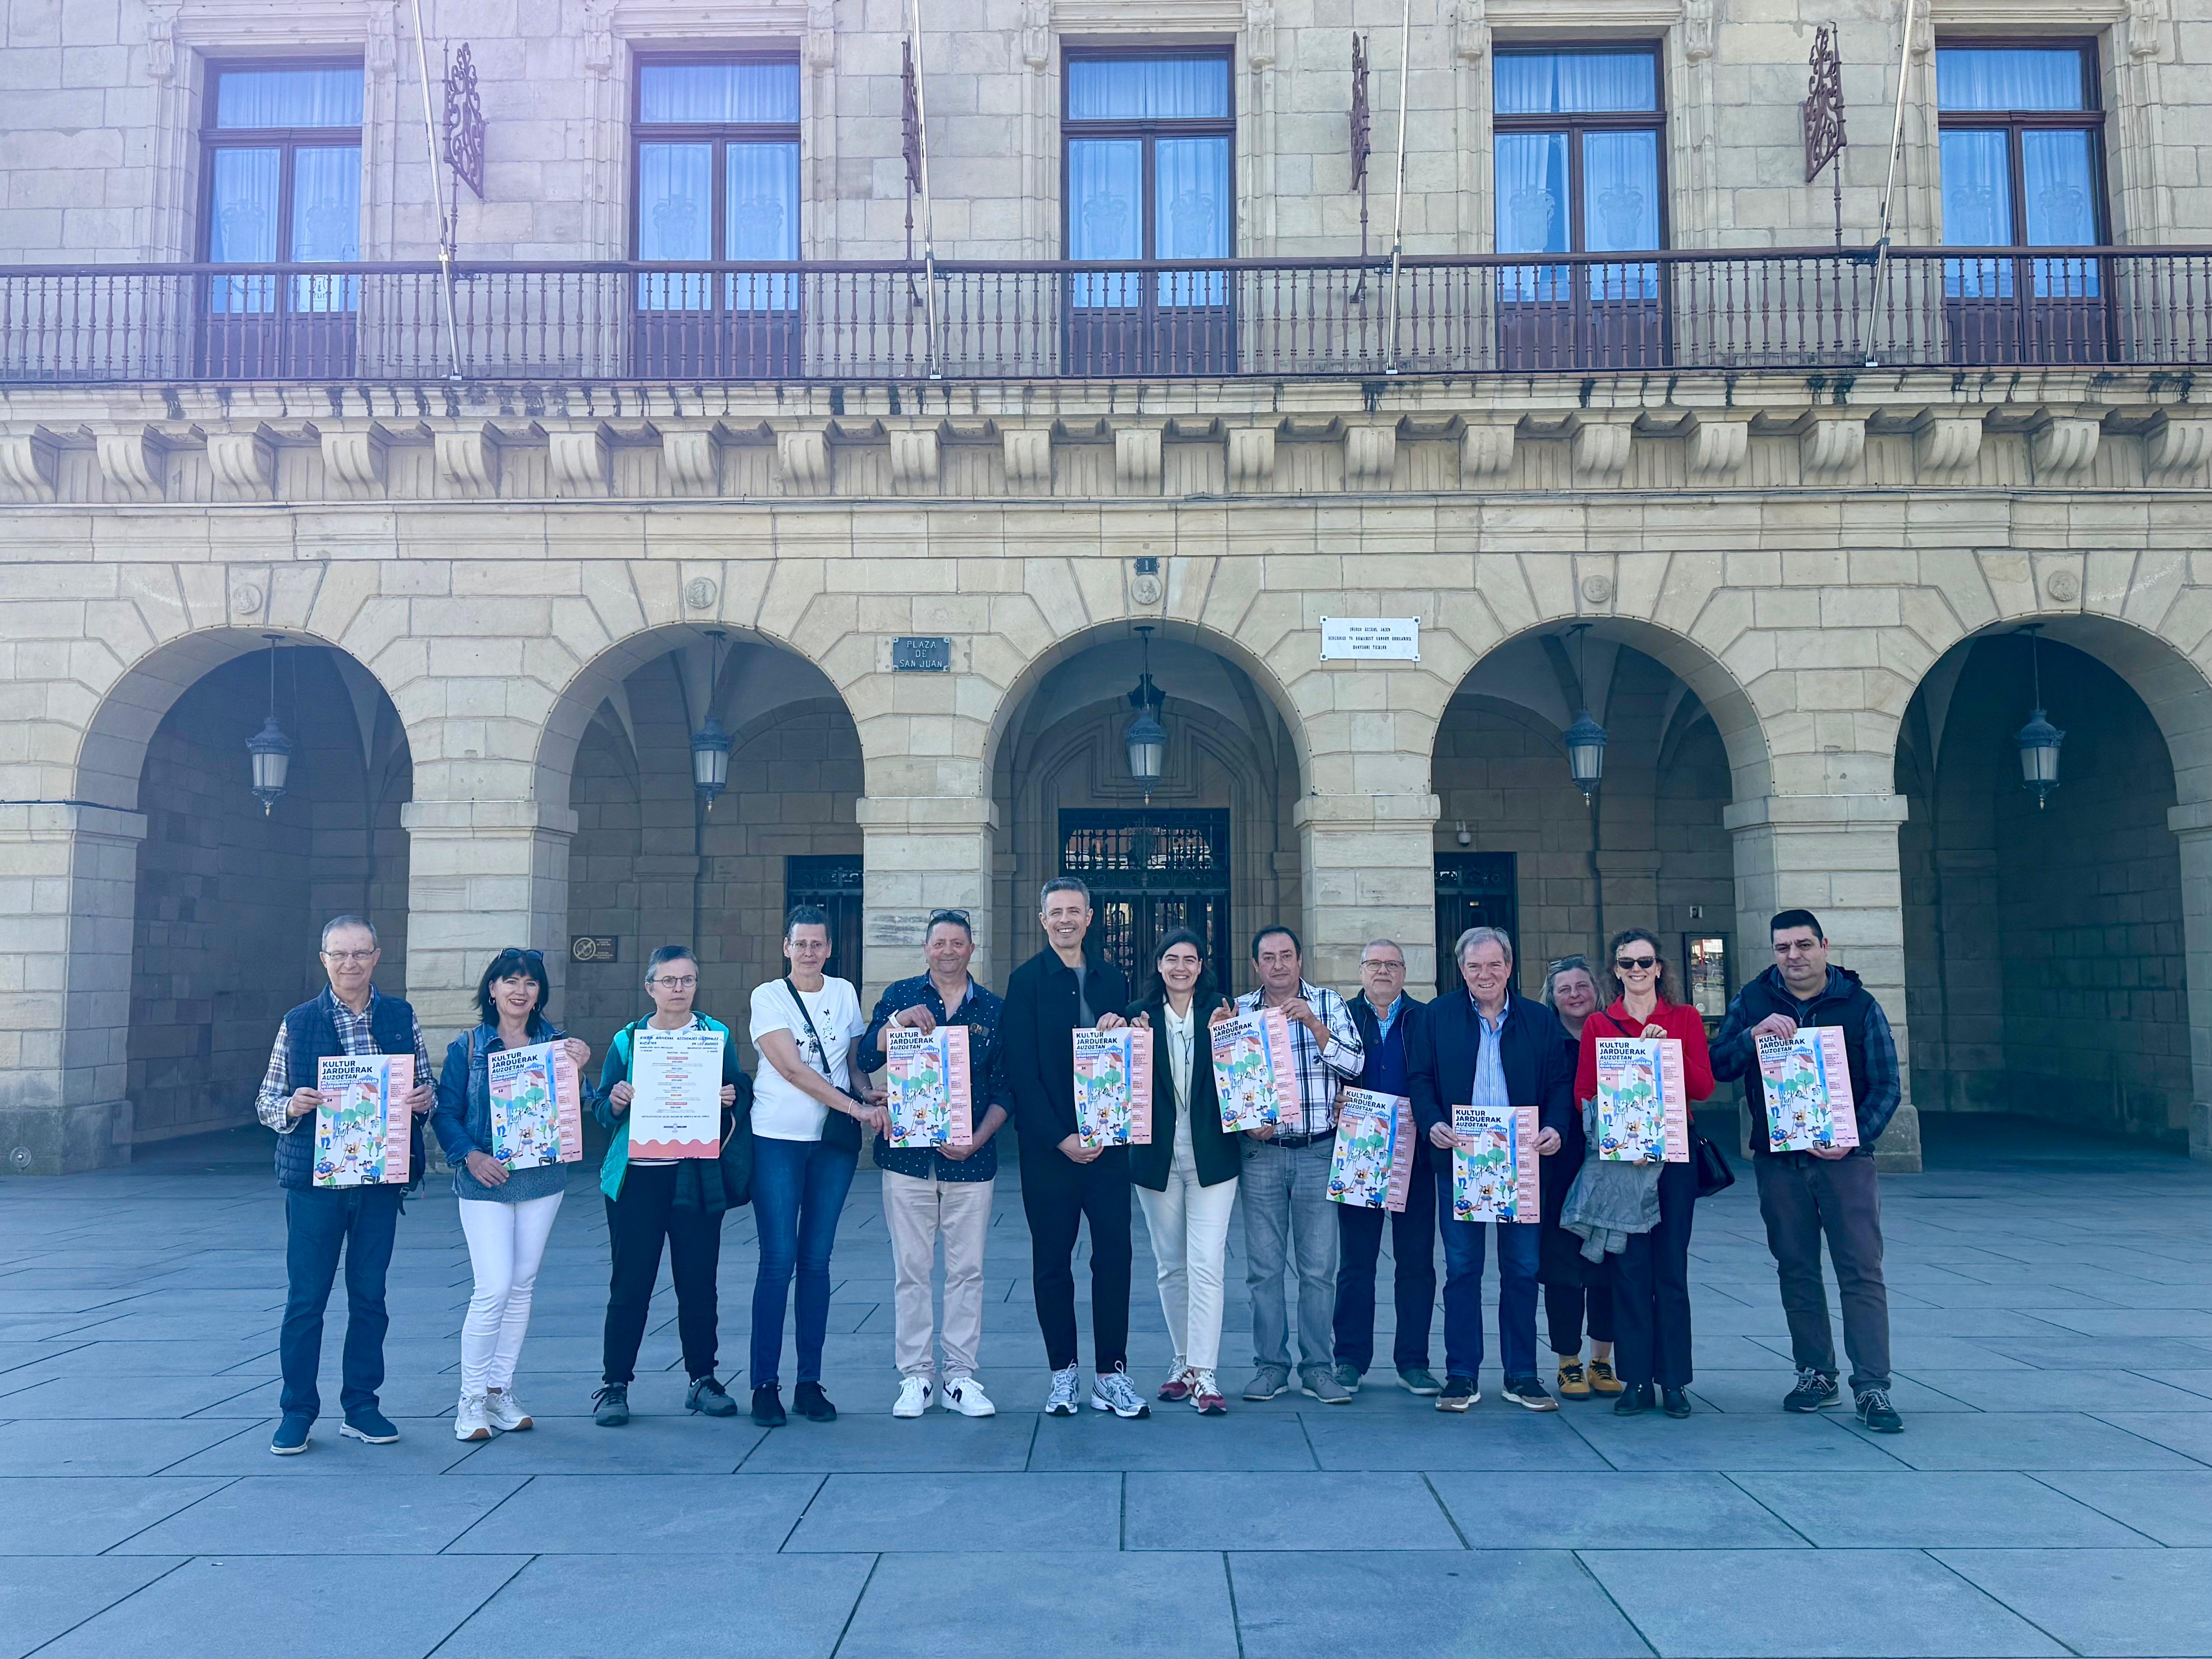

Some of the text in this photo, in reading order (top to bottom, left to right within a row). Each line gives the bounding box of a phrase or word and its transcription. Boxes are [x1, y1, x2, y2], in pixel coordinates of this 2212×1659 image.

[1145, 560, 1149, 570] 1
[907, 640, 936, 648] PLAZA
[900, 659, 942, 668] SAN JUAN
[1213, 1021, 1239, 1032] KULTUR
[1214, 1022, 1253, 1038] JARDUERAK
[890, 1037, 933, 1045] JARDUERAK
[1759, 1035, 1782, 1043] KULT
[1760, 1039, 1805, 1050] JARDUERAK
[1761, 1046, 1792, 1054] AUZOETAN
[492, 1052, 521, 1062] KULTUR
[492, 1055, 538, 1069] JARDUERAK
[322, 1066, 373, 1075] JARDUERAK
[1346, 1090, 1373, 1101] KULTUR
[1350, 1097, 1386, 1110] ARDUERAK
